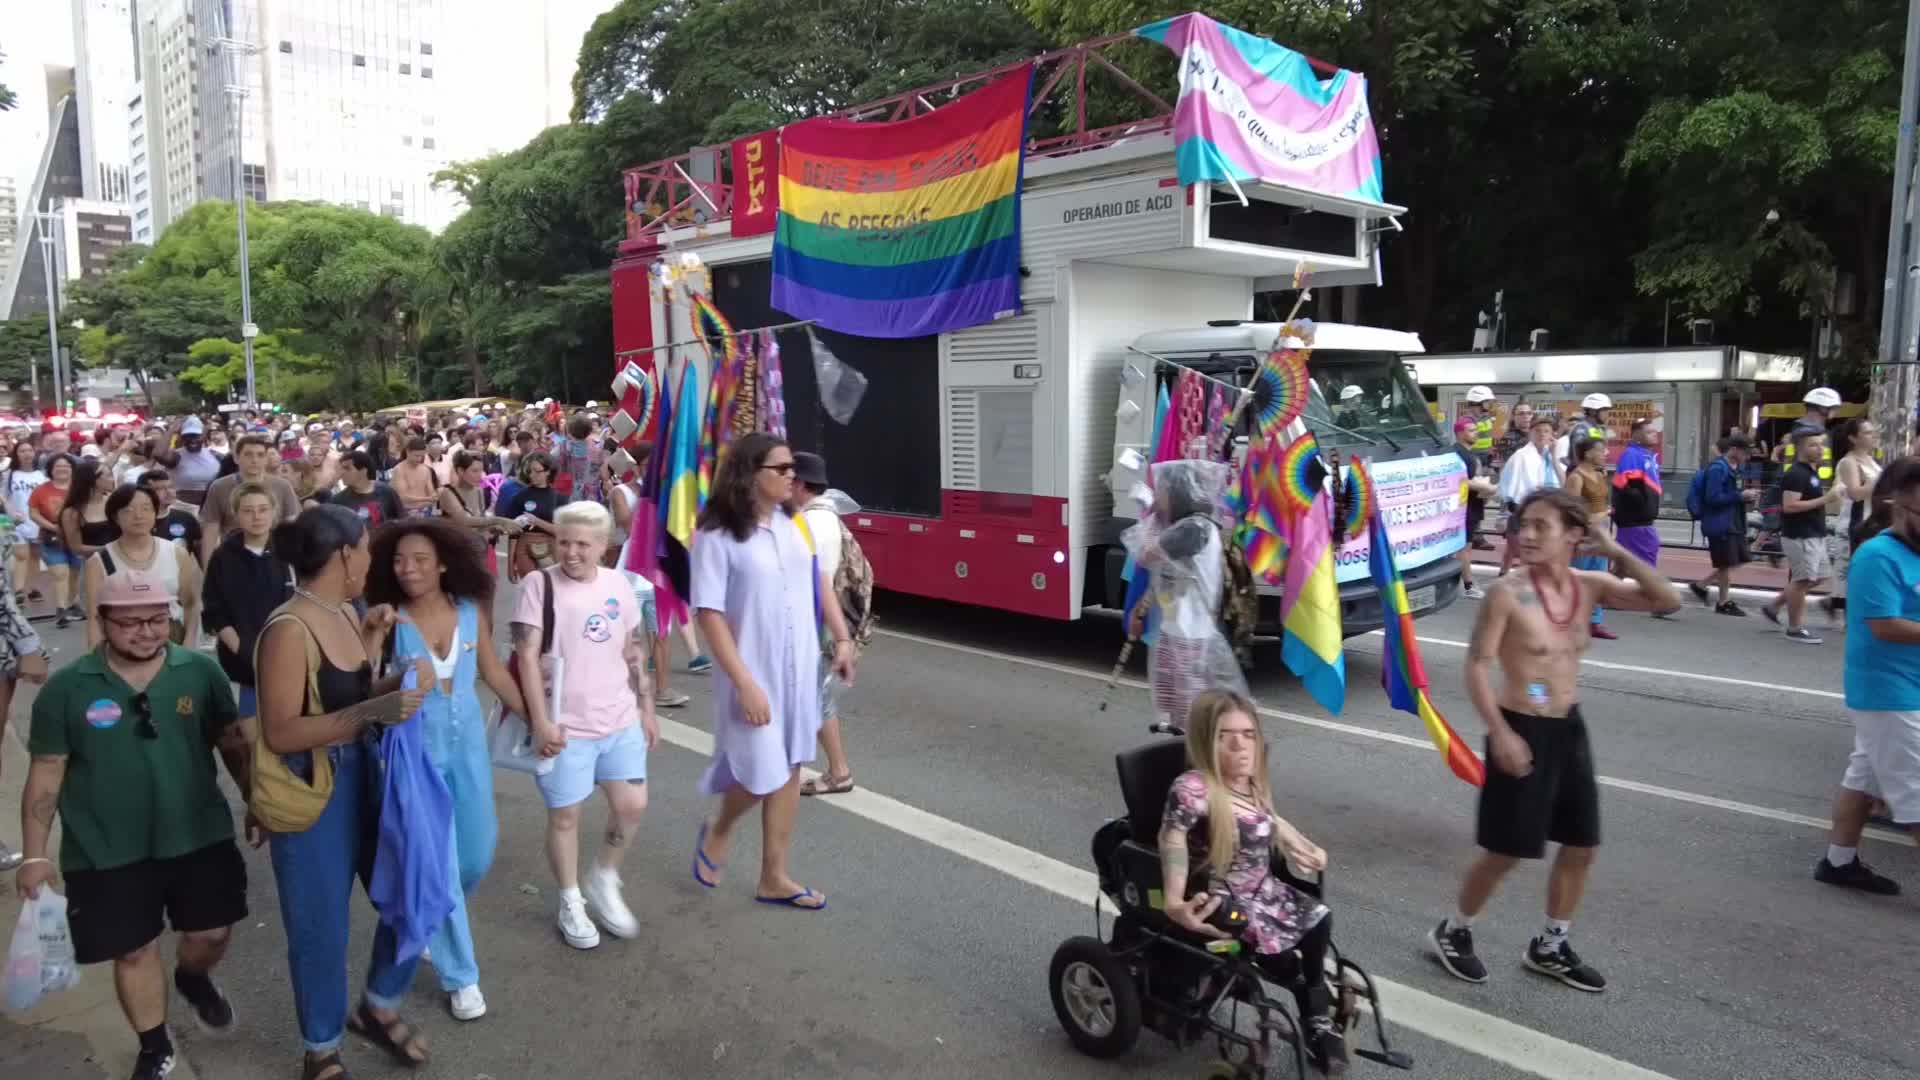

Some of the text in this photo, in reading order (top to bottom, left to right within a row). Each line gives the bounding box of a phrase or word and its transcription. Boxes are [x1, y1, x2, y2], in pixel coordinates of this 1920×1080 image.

[803, 160, 848, 192] DEUS
[818, 211, 842, 235] AS
[1063, 201, 1122, 223] OPERÁRIO
[1125, 199, 1140, 215] DE
